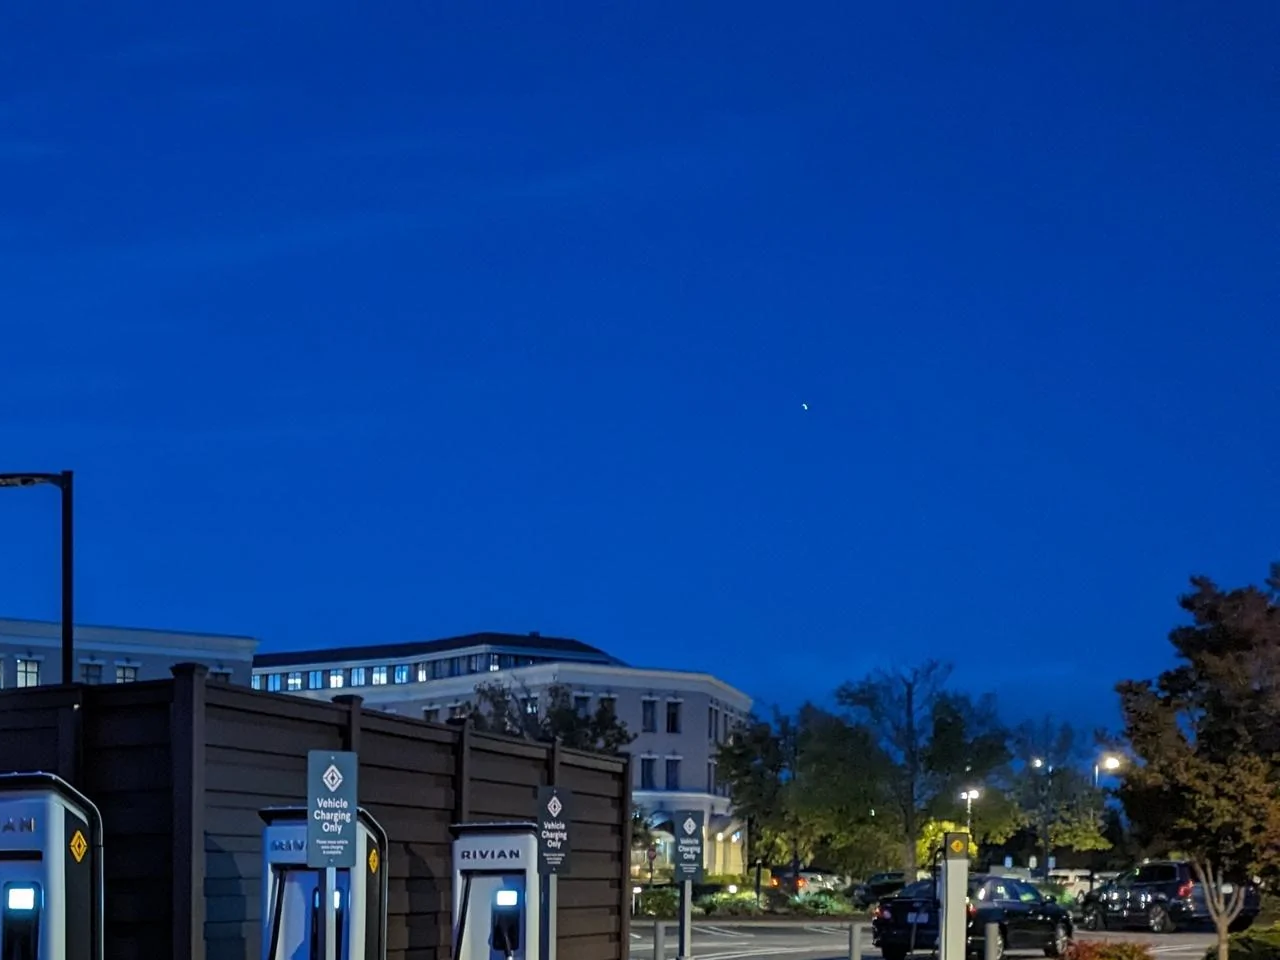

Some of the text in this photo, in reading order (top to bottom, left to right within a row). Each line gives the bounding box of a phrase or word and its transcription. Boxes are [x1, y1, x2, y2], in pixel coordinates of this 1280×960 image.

[317, 797, 348, 809] Vehicle
[313, 810, 351, 824] Charging
[322, 822, 343, 835] Only
[543, 821, 565, 830] Vehicle
[541, 830, 568, 841] Charging
[547, 839, 562, 850] Only
[461, 849, 520, 860] RIVIAN
